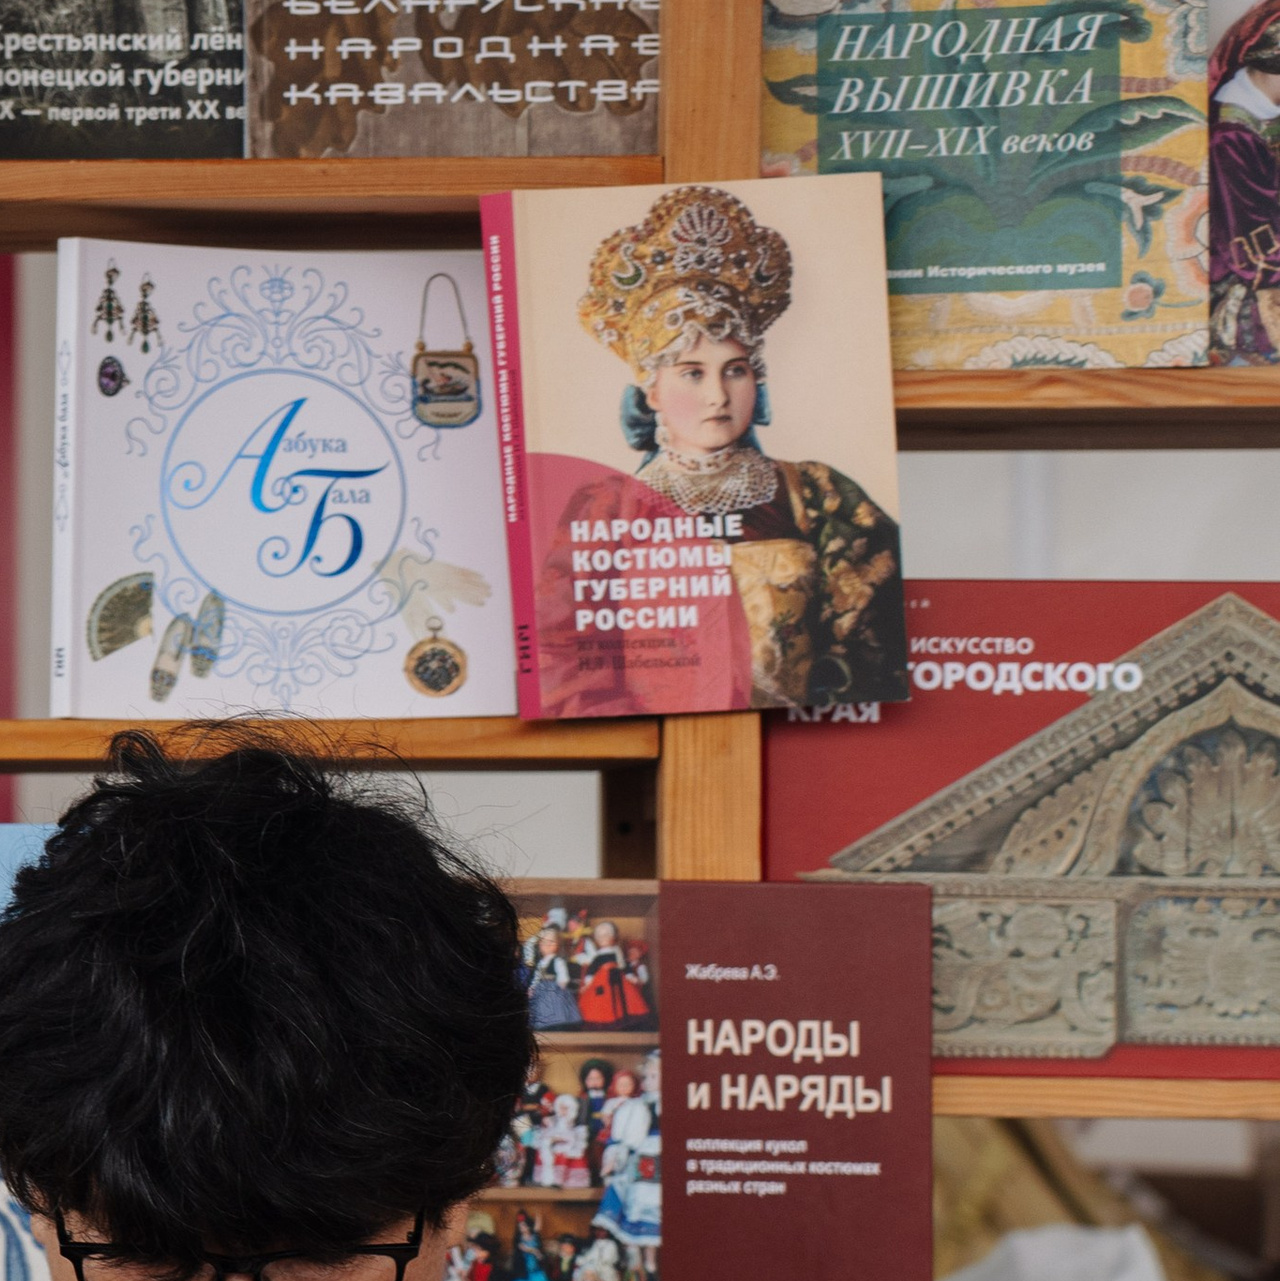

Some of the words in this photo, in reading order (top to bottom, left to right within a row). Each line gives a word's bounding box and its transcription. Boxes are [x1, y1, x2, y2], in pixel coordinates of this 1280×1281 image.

[190, 26, 244, 52] лён
[828, 14, 1107, 64] НАРОДНАЯ
[827, 67, 1095, 115] ВЫШИВКА
[47, 103, 120, 127] первой
[125, 105, 182, 126] трети
[186, 99, 221, 120] XX
[1001, 130, 1095, 155] веков
[489, 235, 503, 291] РОССИИ
[927, 263, 1052, 279] Исторического
[1056, 261, 1107, 276] музея
[492, 294, 508, 367] ГУБЕРНИЙ
[498, 369, 513, 442] КОСТЮМЫ
[503, 445, 518, 523] НАРОДНЫЕ
[570, 513, 744, 544] НАРОДНЫЕ
[572, 544, 732, 573] КОСТЮМЫ
[573, 567, 732, 602] ГУБЕРНИЙ
[575, 605, 699, 632] РОССИИ
[910, 637, 1035, 655] ИСКУССТВО
[686, 1019, 860, 1064] НАРОДЫ
[687, 1082, 711, 1110] и
[721, 1073, 893, 1120] НАРЯДЫ
[686, 1138, 763, 1155] коллекция
[765, 1140, 808, 1157] кукол
[686, 1159, 698, 1172] в
[699, 1159, 807, 1175] традиционных
[808, 1161, 882, 1176] костюмах
[686, 1179, 741, 1196] разных
[743, 1181, 787, 1198] стран
